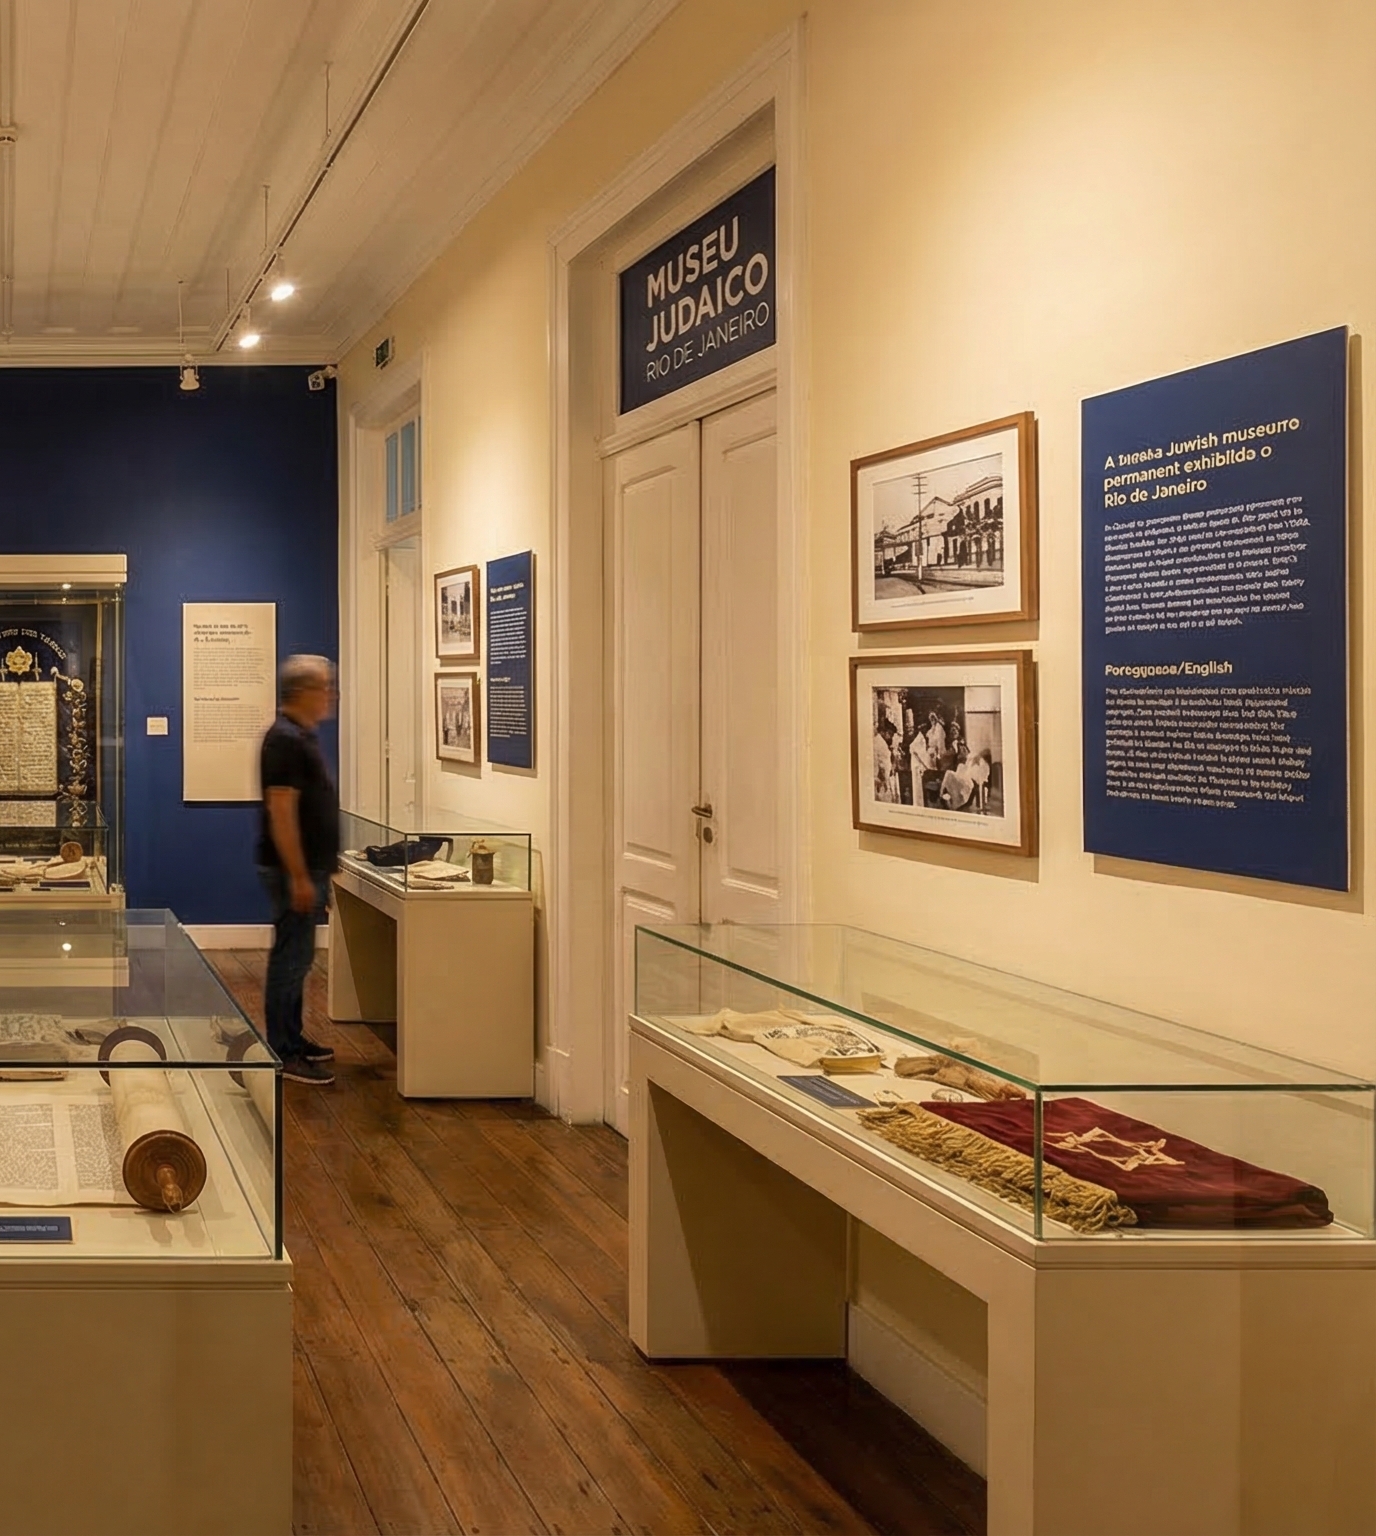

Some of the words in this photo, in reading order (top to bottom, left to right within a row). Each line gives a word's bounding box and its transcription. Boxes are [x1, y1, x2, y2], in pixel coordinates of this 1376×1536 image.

[646, 252, 769, 352] JUDAICO
[647, 215, 739, 308] MUSEU
[646, 354, 671, 383] RIO
[673, 340, 694, 371] DE
[697, 301, 770, 357] JANEIRO
[1104, 463, 1181, 493] permanent
[1104, 493, 1127, 509] Rio
[1130, 488, 1149, 502] de
[1151, 479, 1208, 500] Janeiro
